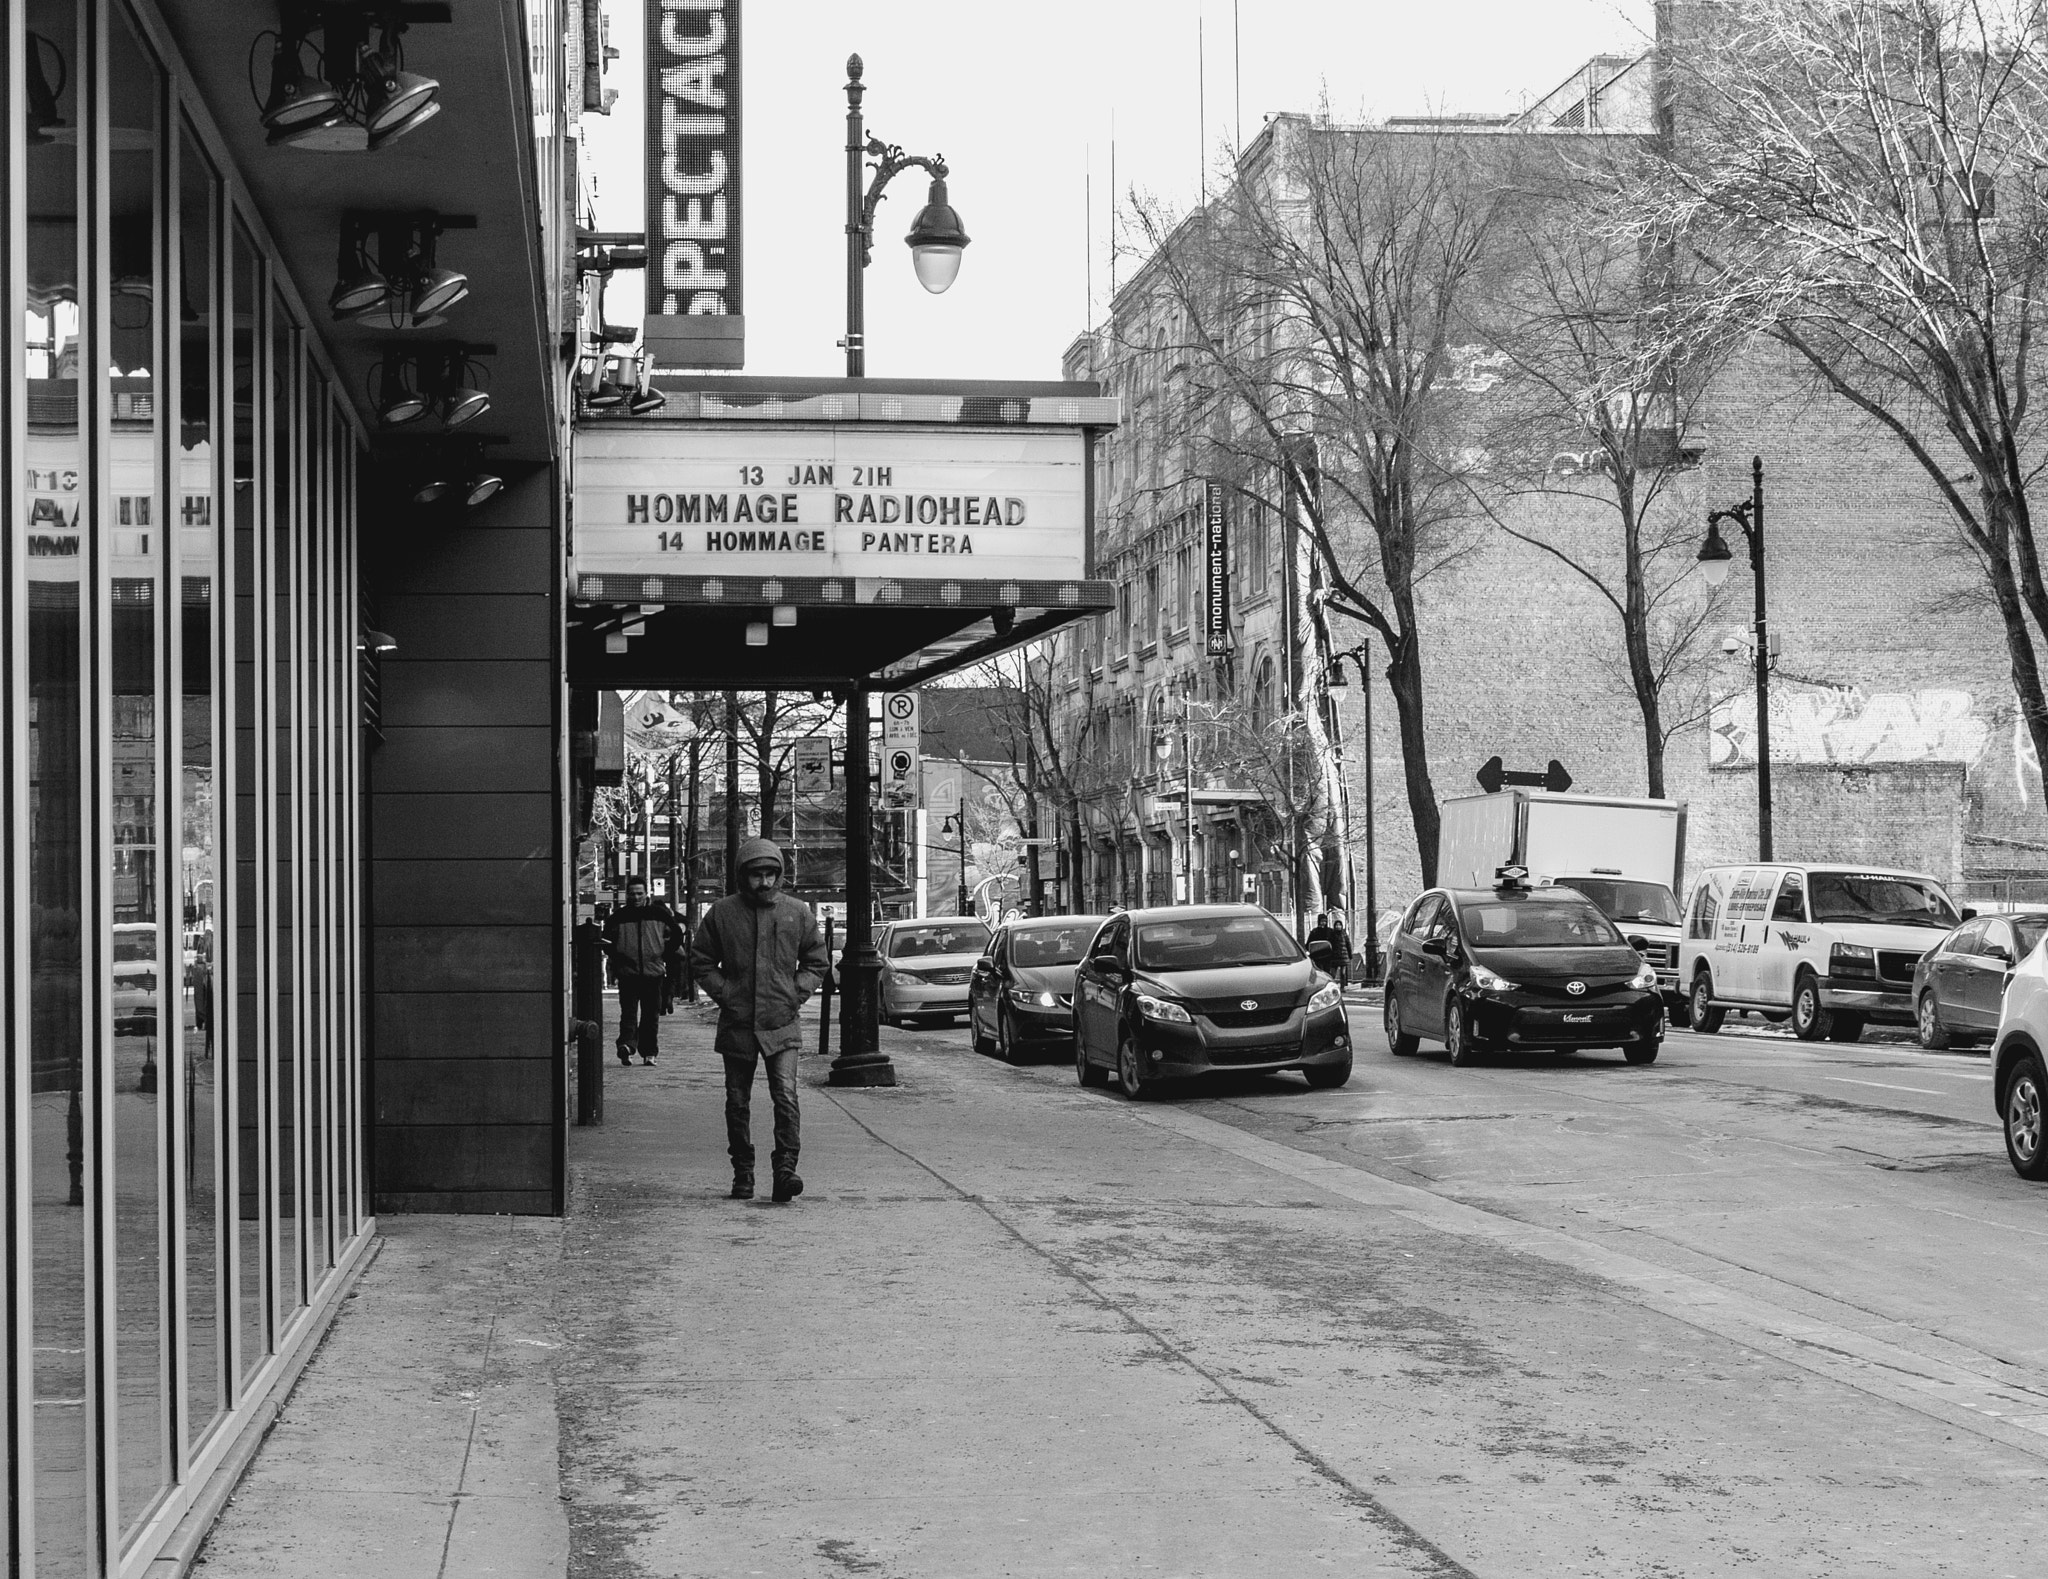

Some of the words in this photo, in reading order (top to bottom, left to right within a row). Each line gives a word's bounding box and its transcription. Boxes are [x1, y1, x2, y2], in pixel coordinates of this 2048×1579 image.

[739, 466, 764, 485] 13
[788, 465, 833, 485] JAN
[627, 493, 798, 523] HOMMAGE
[834, 493, 1026, 526] RADIOHEAD
[658, 531, 684, 551] 14
[706, 531, 825, 551] HOMMAGE
[862, 531, 973, 553] PANTERA
[1209, 484, 1222, 629] monument-national
[1860, 873, 1898, 882] U-HAUL
